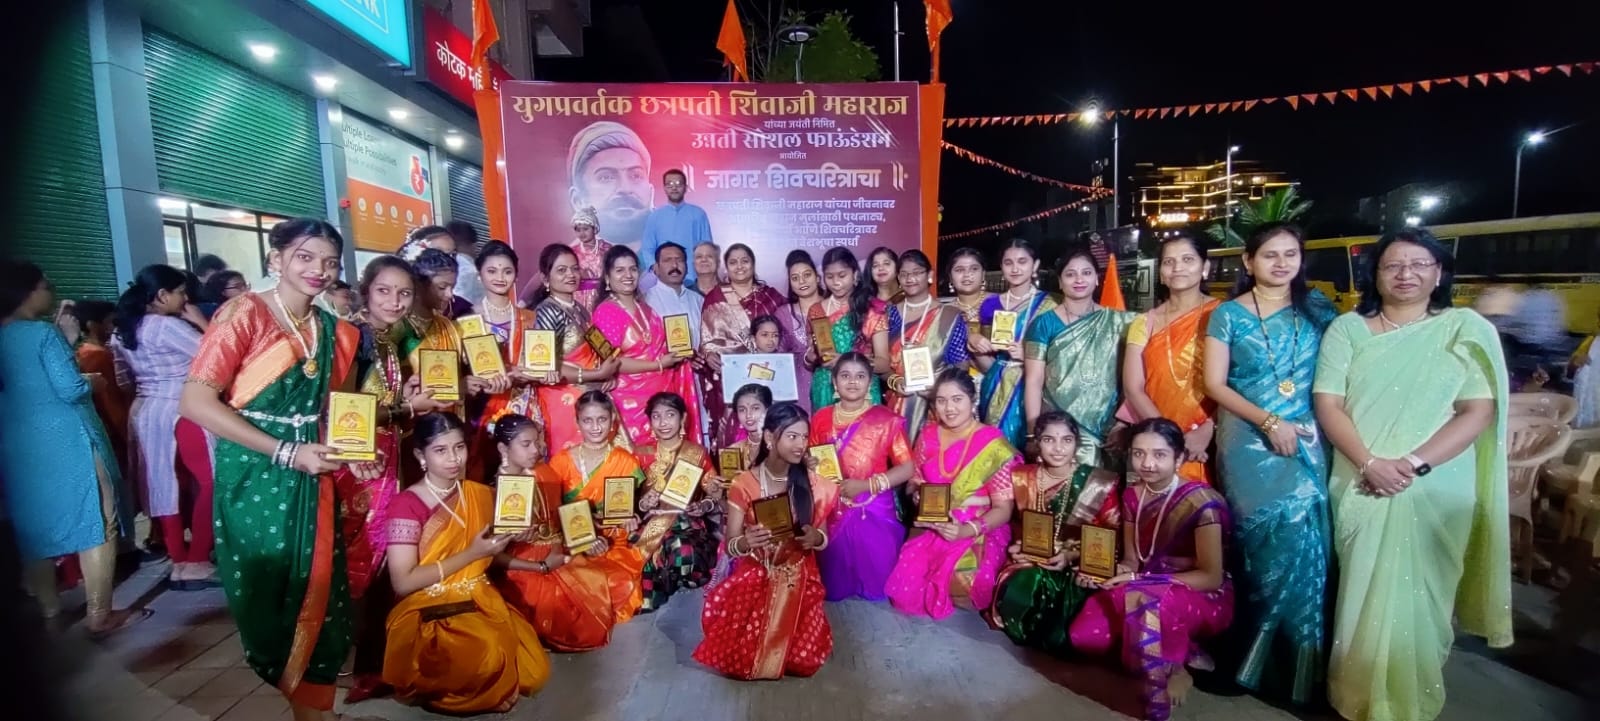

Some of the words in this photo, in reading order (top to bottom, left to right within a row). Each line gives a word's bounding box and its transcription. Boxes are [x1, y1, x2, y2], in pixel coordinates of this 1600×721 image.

[435, 40, 467, 80] कोटक
[511, 88, 634, 123] युगप्रवर्तक
[638, 90, 722, 116] छत्रपती
[729, 89, 817, 116] शिवाजी
[821, 95, 909, 116] महाराज
[691, 127, 737, 149] उन्नती
[742, 127, 802, 149] सोशल
[805, 126, 891, 149] फाऊंडेशन
[704, 168, 761, 190] जागर
[765, 162, 882, 190] शिवचरित्राचा
[787, 199, 822, 210] महाराज
[824, 197, 851, 209] यांच्या
[852, 197, 896, 209] जीवनावर
[820, 222, 878, 234] शिवचरित्रावर
[835, 234, 861, 247] स्पर्धा
